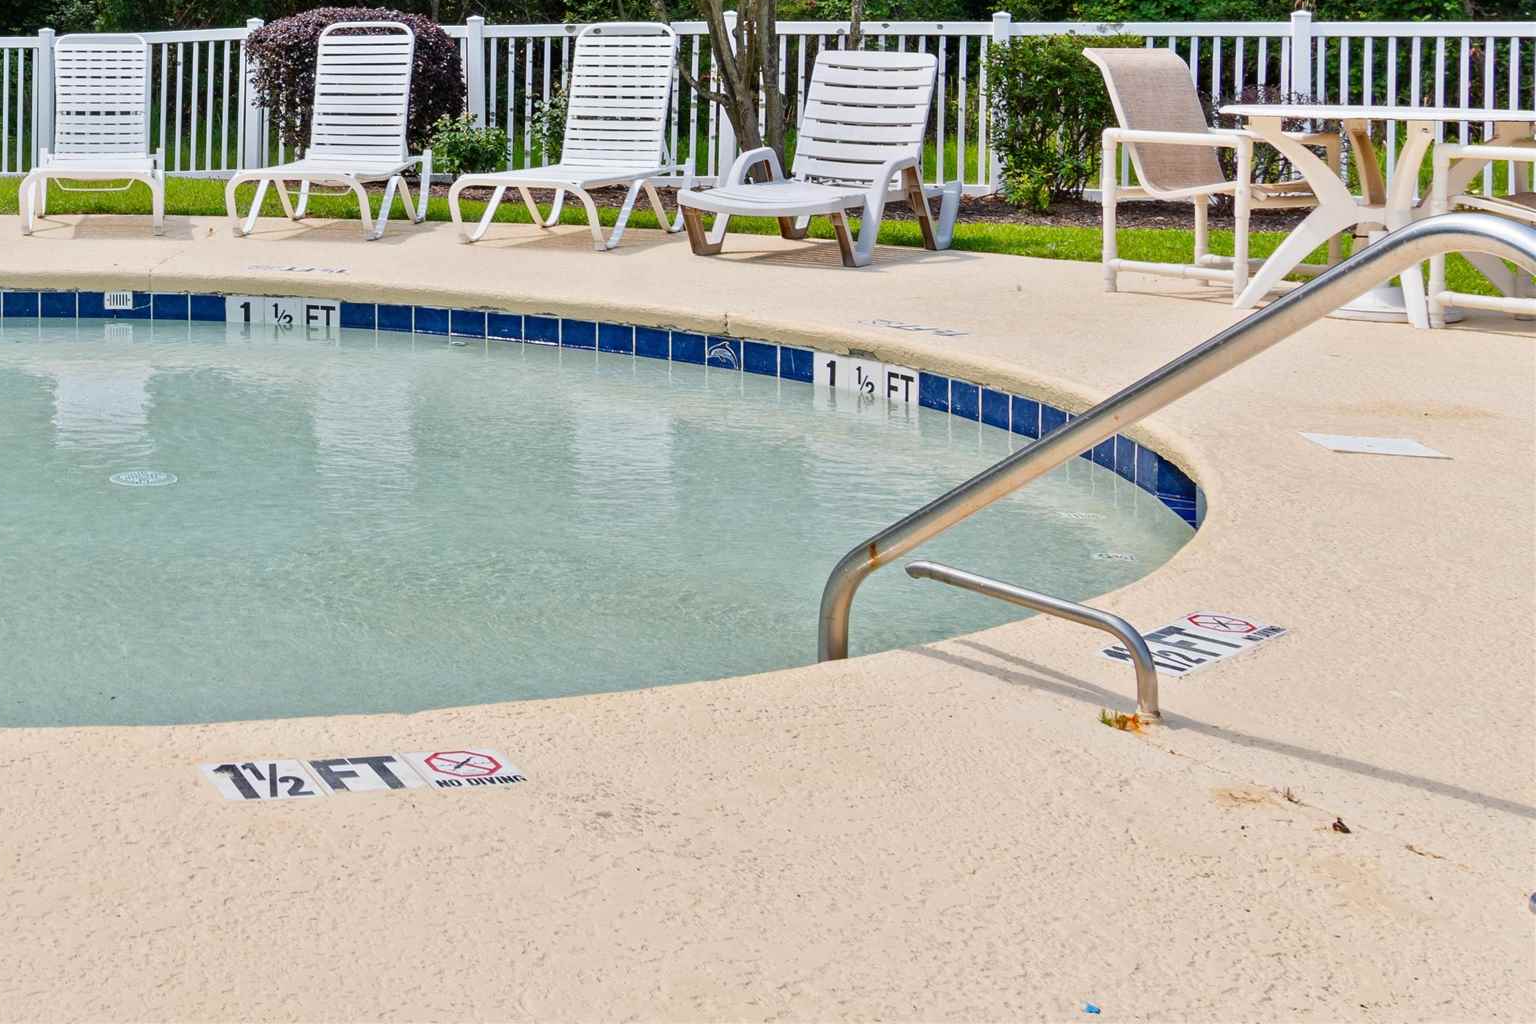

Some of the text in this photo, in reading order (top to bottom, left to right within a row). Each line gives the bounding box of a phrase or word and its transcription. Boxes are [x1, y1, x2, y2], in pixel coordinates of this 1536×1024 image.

[239, 301, 251, 322] 1
[305, 304, 336, 326] FT
[826, 360, 837, 387] 1
[887, 371, 914, 402] FT
[1142, 625, 1243, 658] FT
[310, 755, 407, 791] FT
[435, 778, 463, 789] NO
